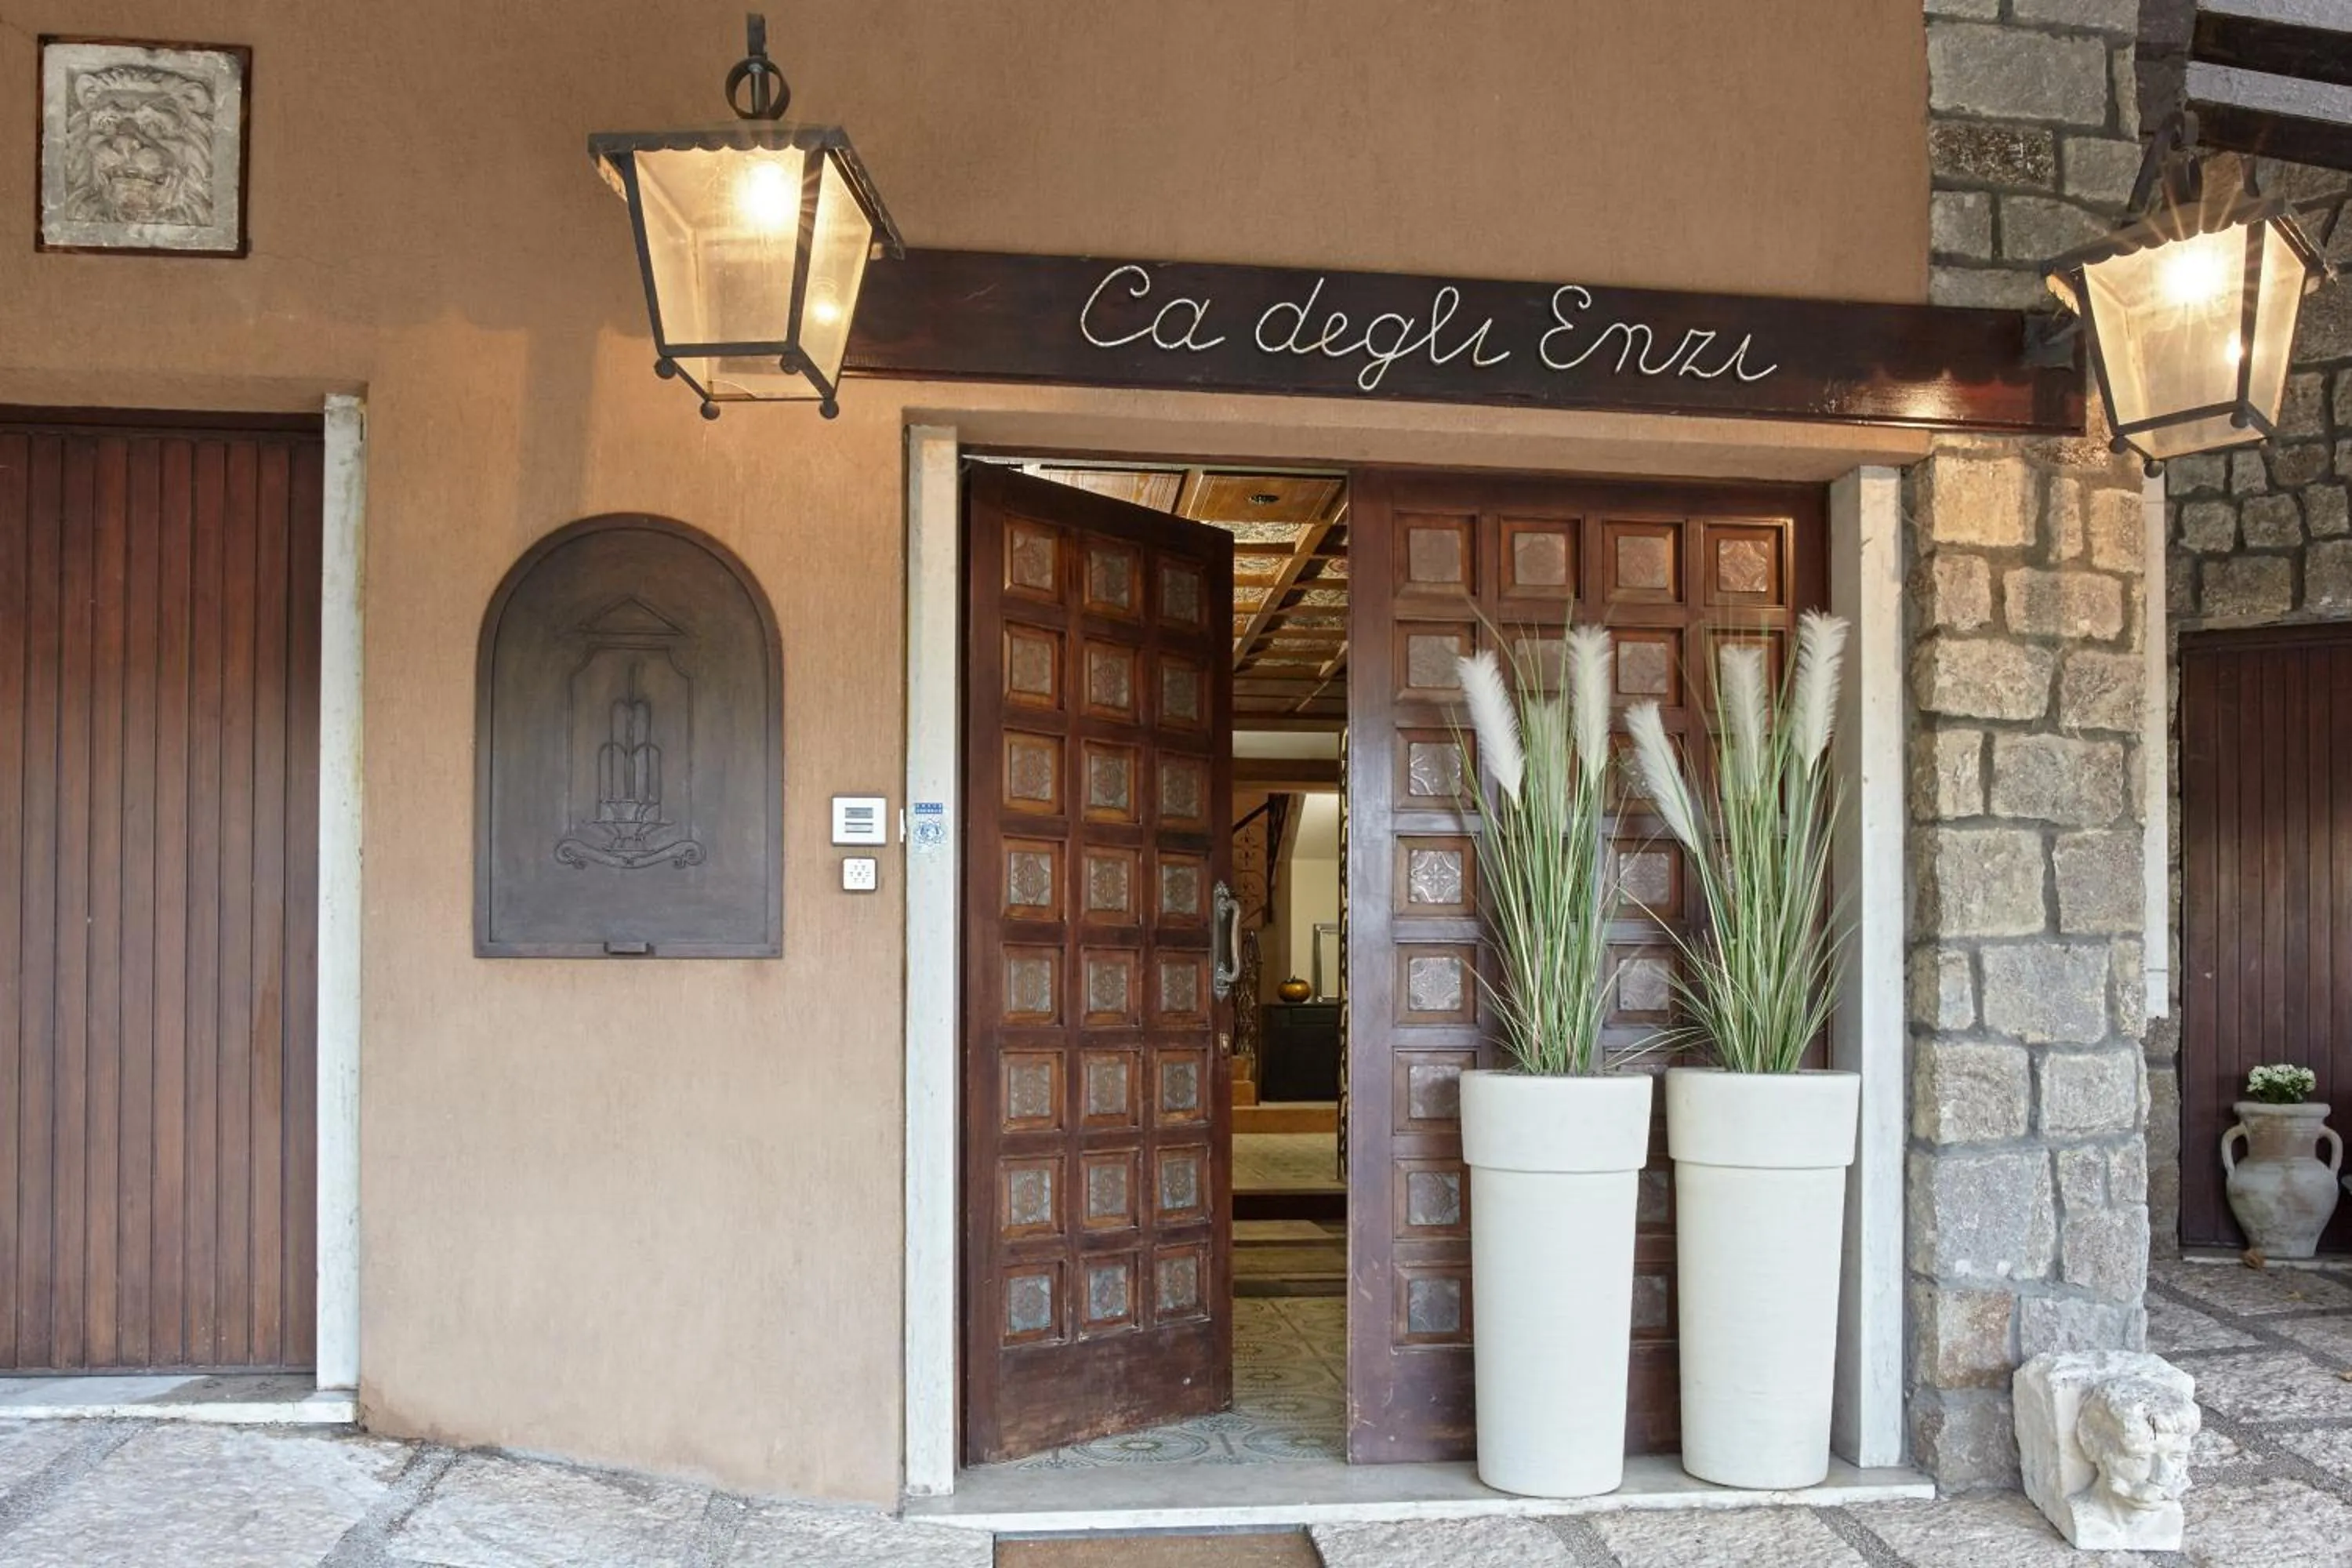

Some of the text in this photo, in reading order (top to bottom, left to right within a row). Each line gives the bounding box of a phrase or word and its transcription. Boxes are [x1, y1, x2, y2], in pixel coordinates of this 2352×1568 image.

[1080, 265, 1777, 390] Ca degli Enzi
